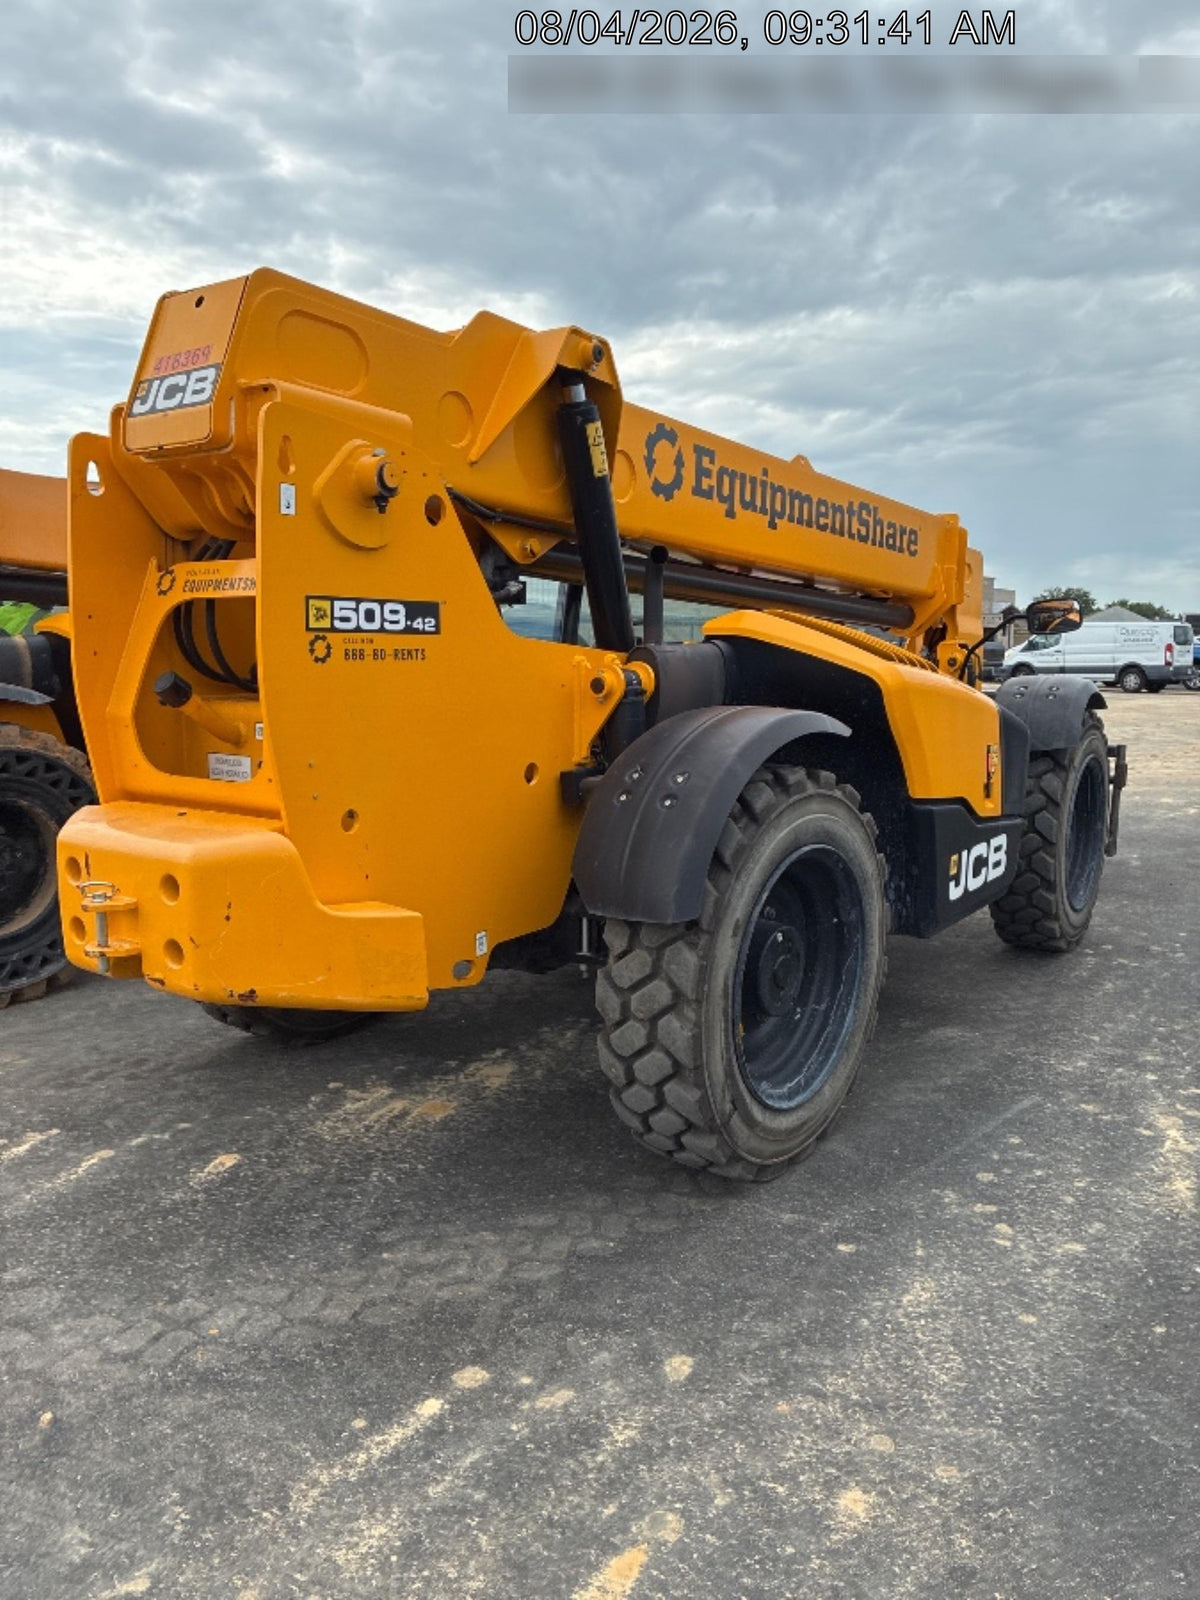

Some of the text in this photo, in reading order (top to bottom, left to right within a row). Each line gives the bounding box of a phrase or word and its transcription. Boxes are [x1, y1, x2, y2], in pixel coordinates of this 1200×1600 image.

[131, 367, 217, 415] JCB
[691, 443, 919, 557] EquipmentShare
[948, 832, 1008, 901] JCB
